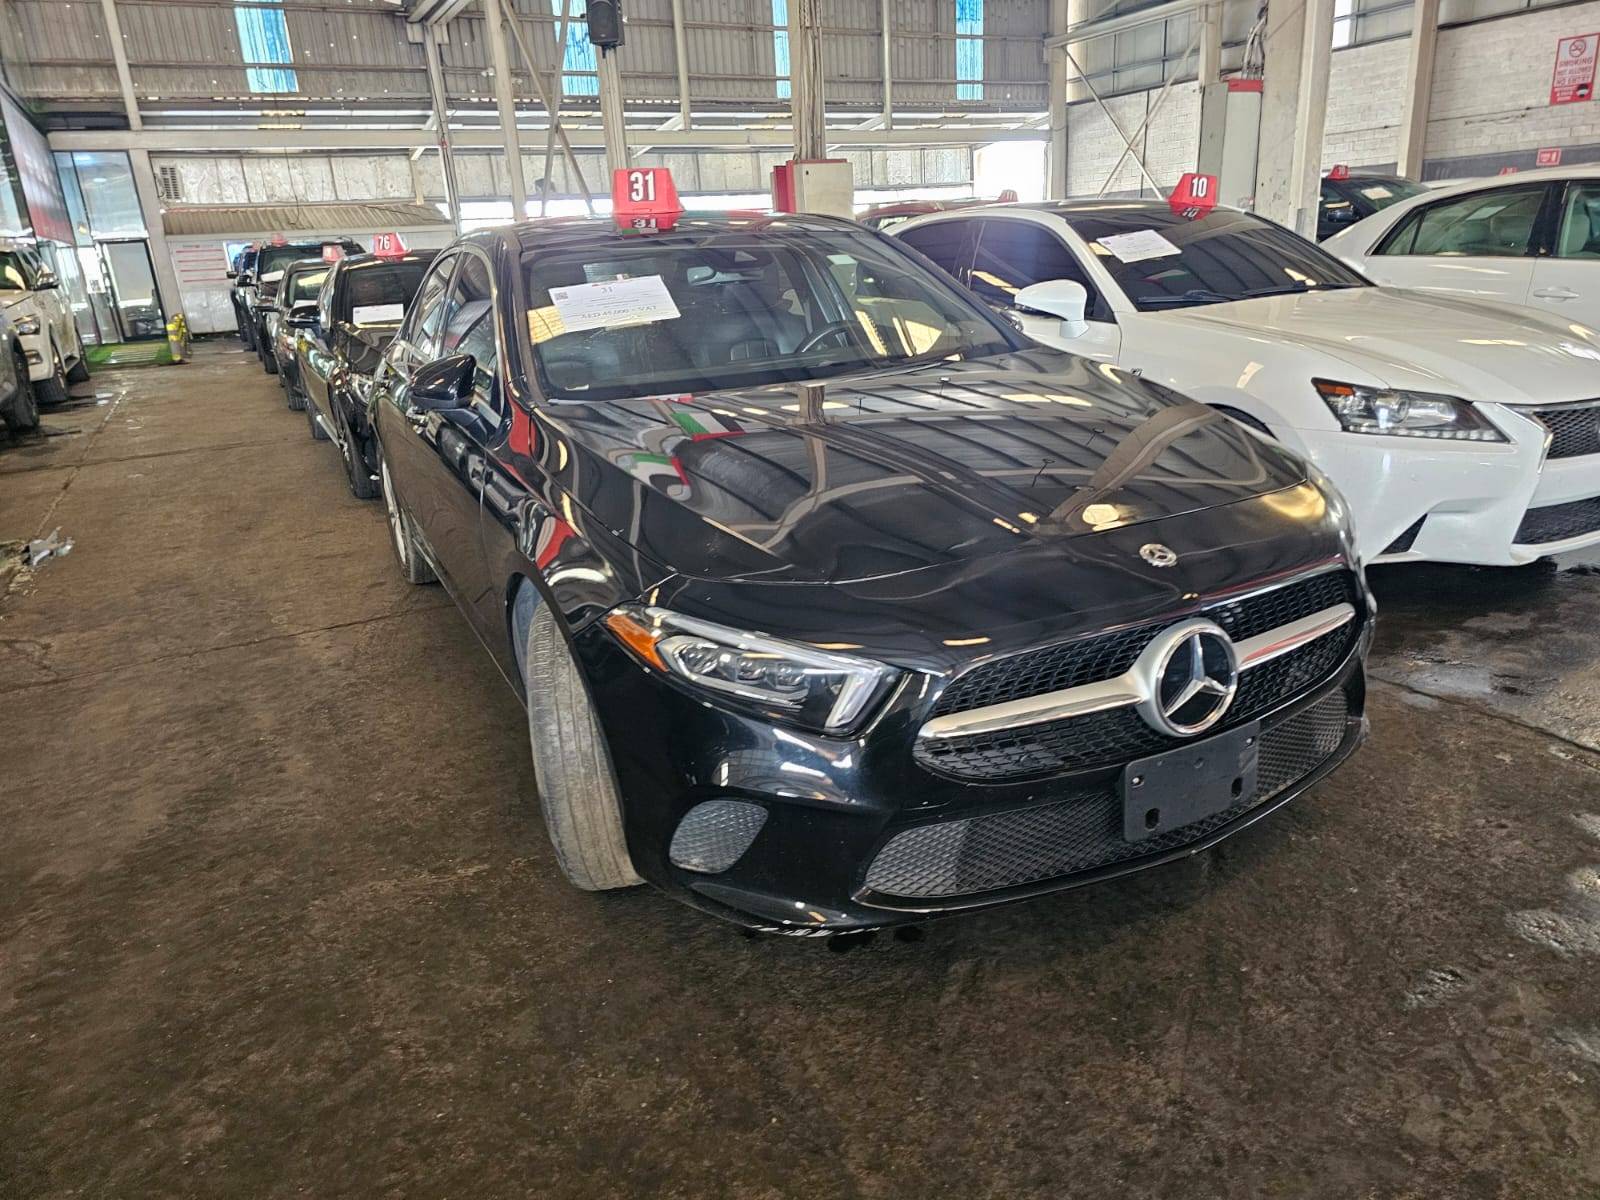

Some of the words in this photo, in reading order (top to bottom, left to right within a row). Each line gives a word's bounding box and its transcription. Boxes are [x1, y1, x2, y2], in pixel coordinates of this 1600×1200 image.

[630, 170, 655, 201] 31
[1192, 176, 1208, 197] 10
[378, 235, 390, 250] 76
